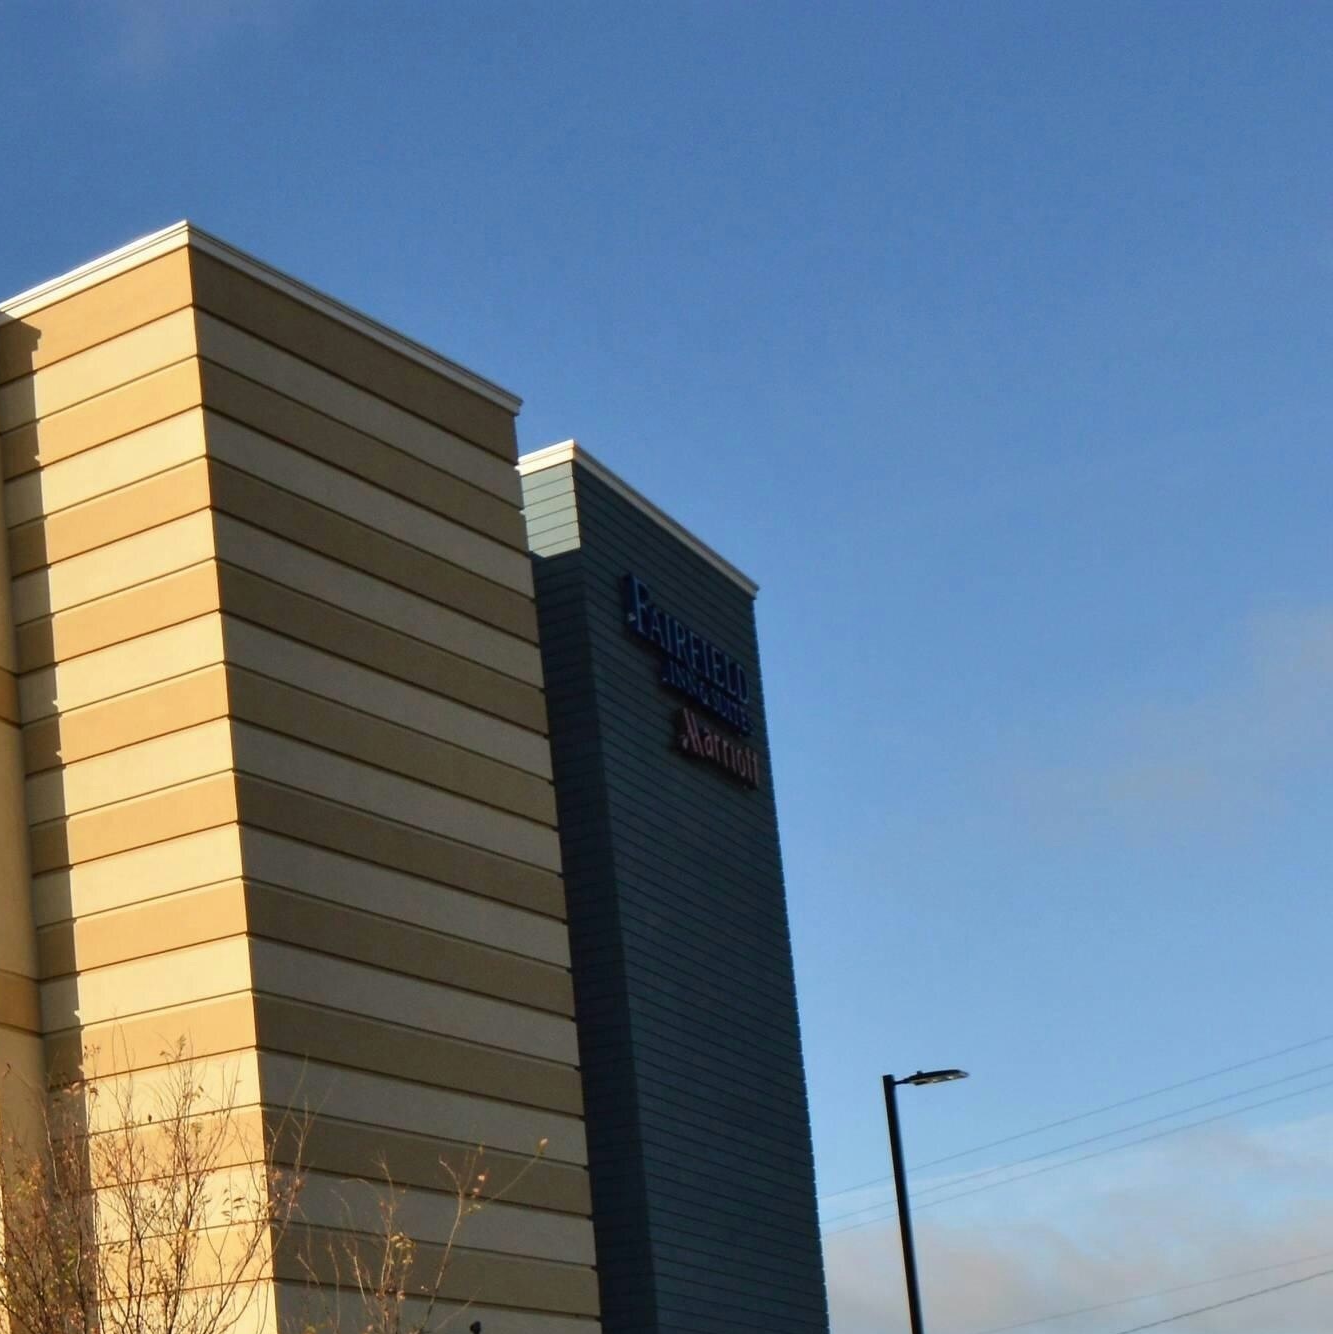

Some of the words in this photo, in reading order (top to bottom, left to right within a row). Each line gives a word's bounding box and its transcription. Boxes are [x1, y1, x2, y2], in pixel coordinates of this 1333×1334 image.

[630, 573, 751, 704] FAIRFIELD
[666, 658, 697, 697] INN
[679, 707, 759, 788] Marriott
